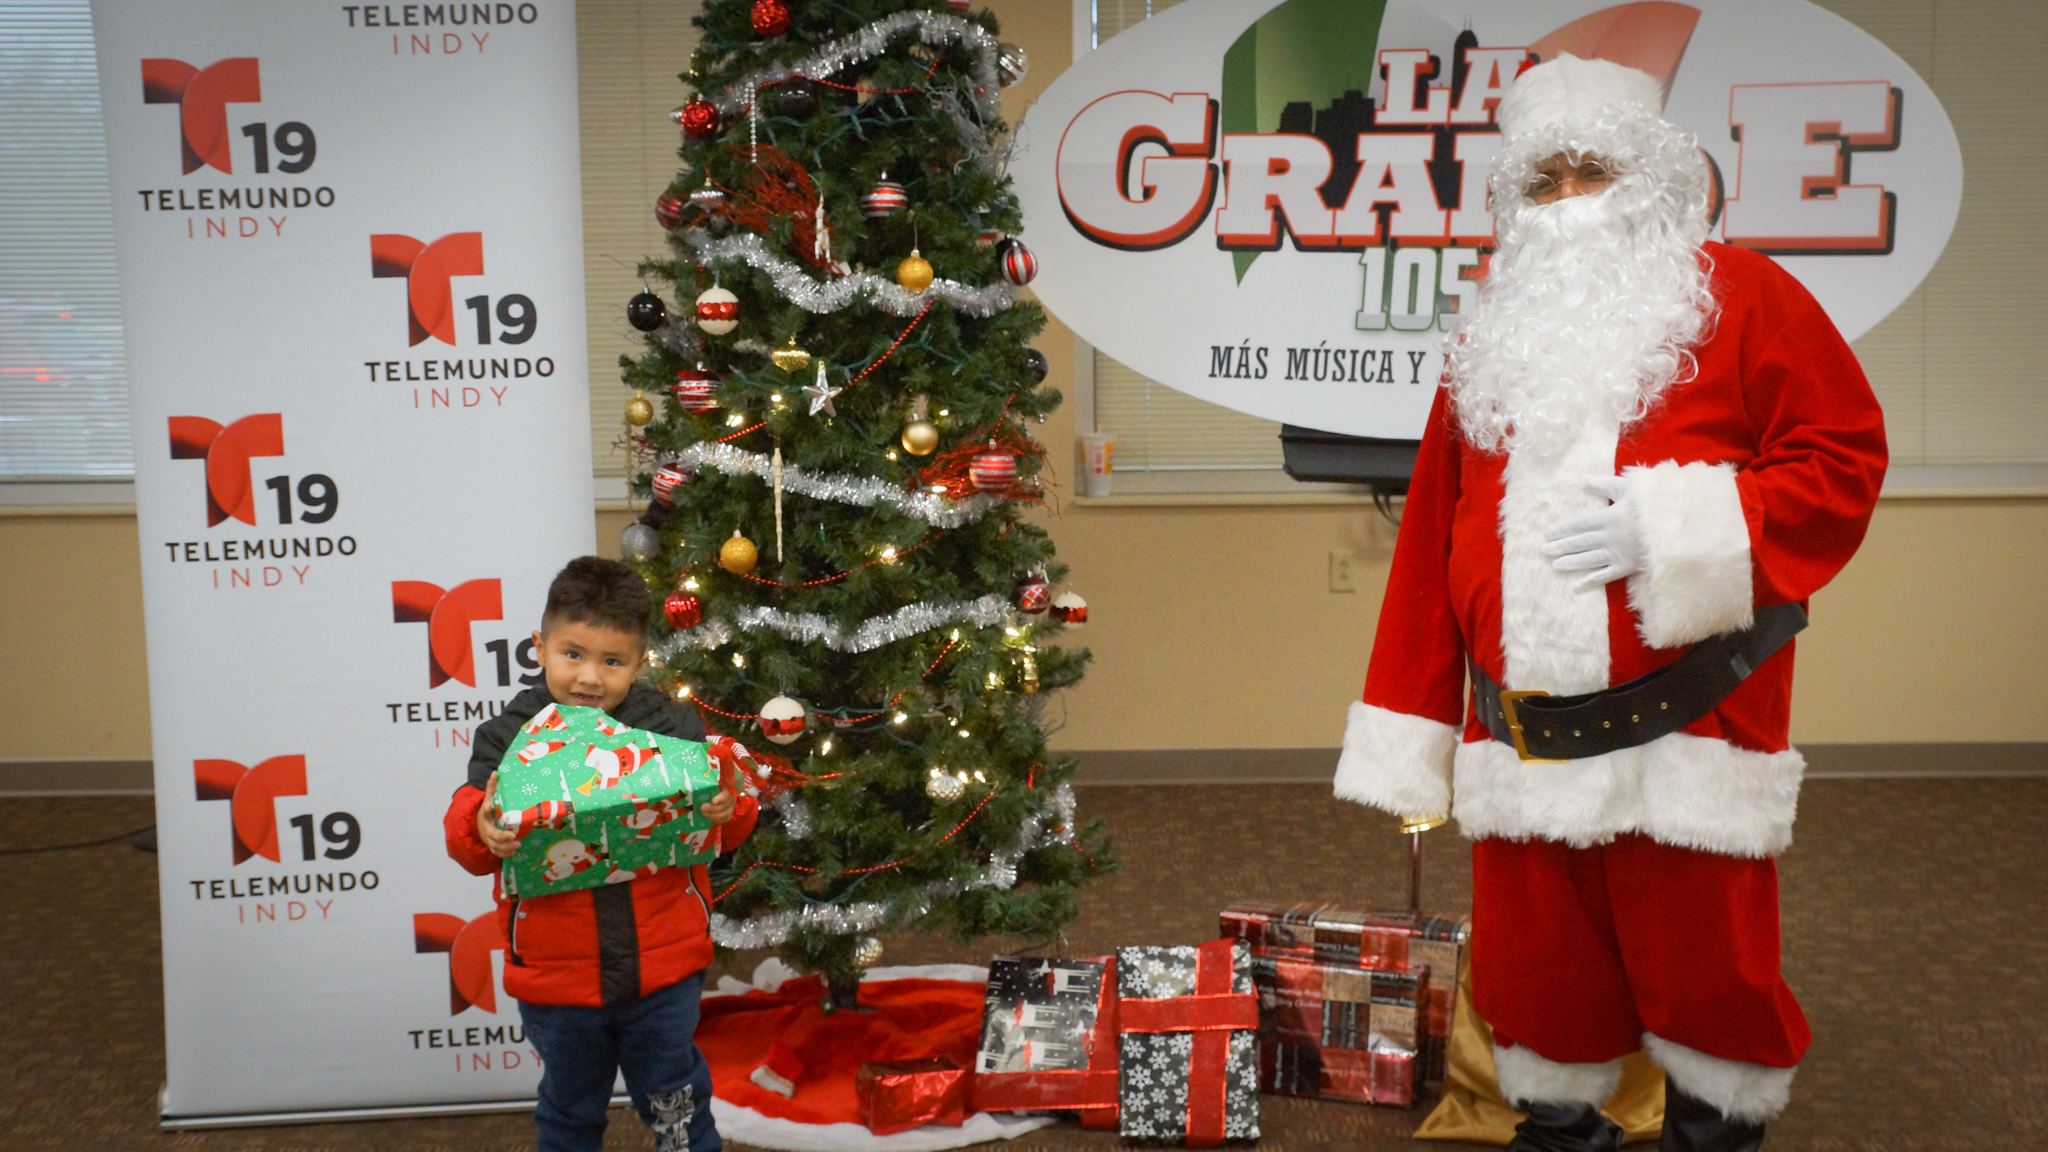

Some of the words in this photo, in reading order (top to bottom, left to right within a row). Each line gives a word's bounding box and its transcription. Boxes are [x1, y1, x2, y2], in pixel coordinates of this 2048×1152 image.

[342, 2, 538, 28] TELEMUNDO
[393, 32, 490, 56] INDY
[1374, 46, 1530, 126] LA
[241, 121, 317, 175] 19
[138, 186, 336, 212] TELEMUNDO
[187, 216, 288, 239] INDY
[465, 294, 538, 346] 19
[364, 357, 556, 383] TELEMUNDO
[1208, 339, 1268, 381] MÁS
[1285, 341, 1395, 384] MÚSICA
[1407, 351, 1426, 385] Y
[413, 386, 508, 409] INDY
[265, 473, 340, 525] 19
[165, 536, 358, 563] TELEMUNDO
[213, 565, 311, 589] INDY
[386, 700, 506, 723] TELEMU
[435, 727, 471, 748] IN
[290, 812, 362, 862] 19
[189, 871, 381, 901] TELEMUNDO
[238, 900, 335, 924] INDY
[408, 1025, 526, 1050] TELEMU
